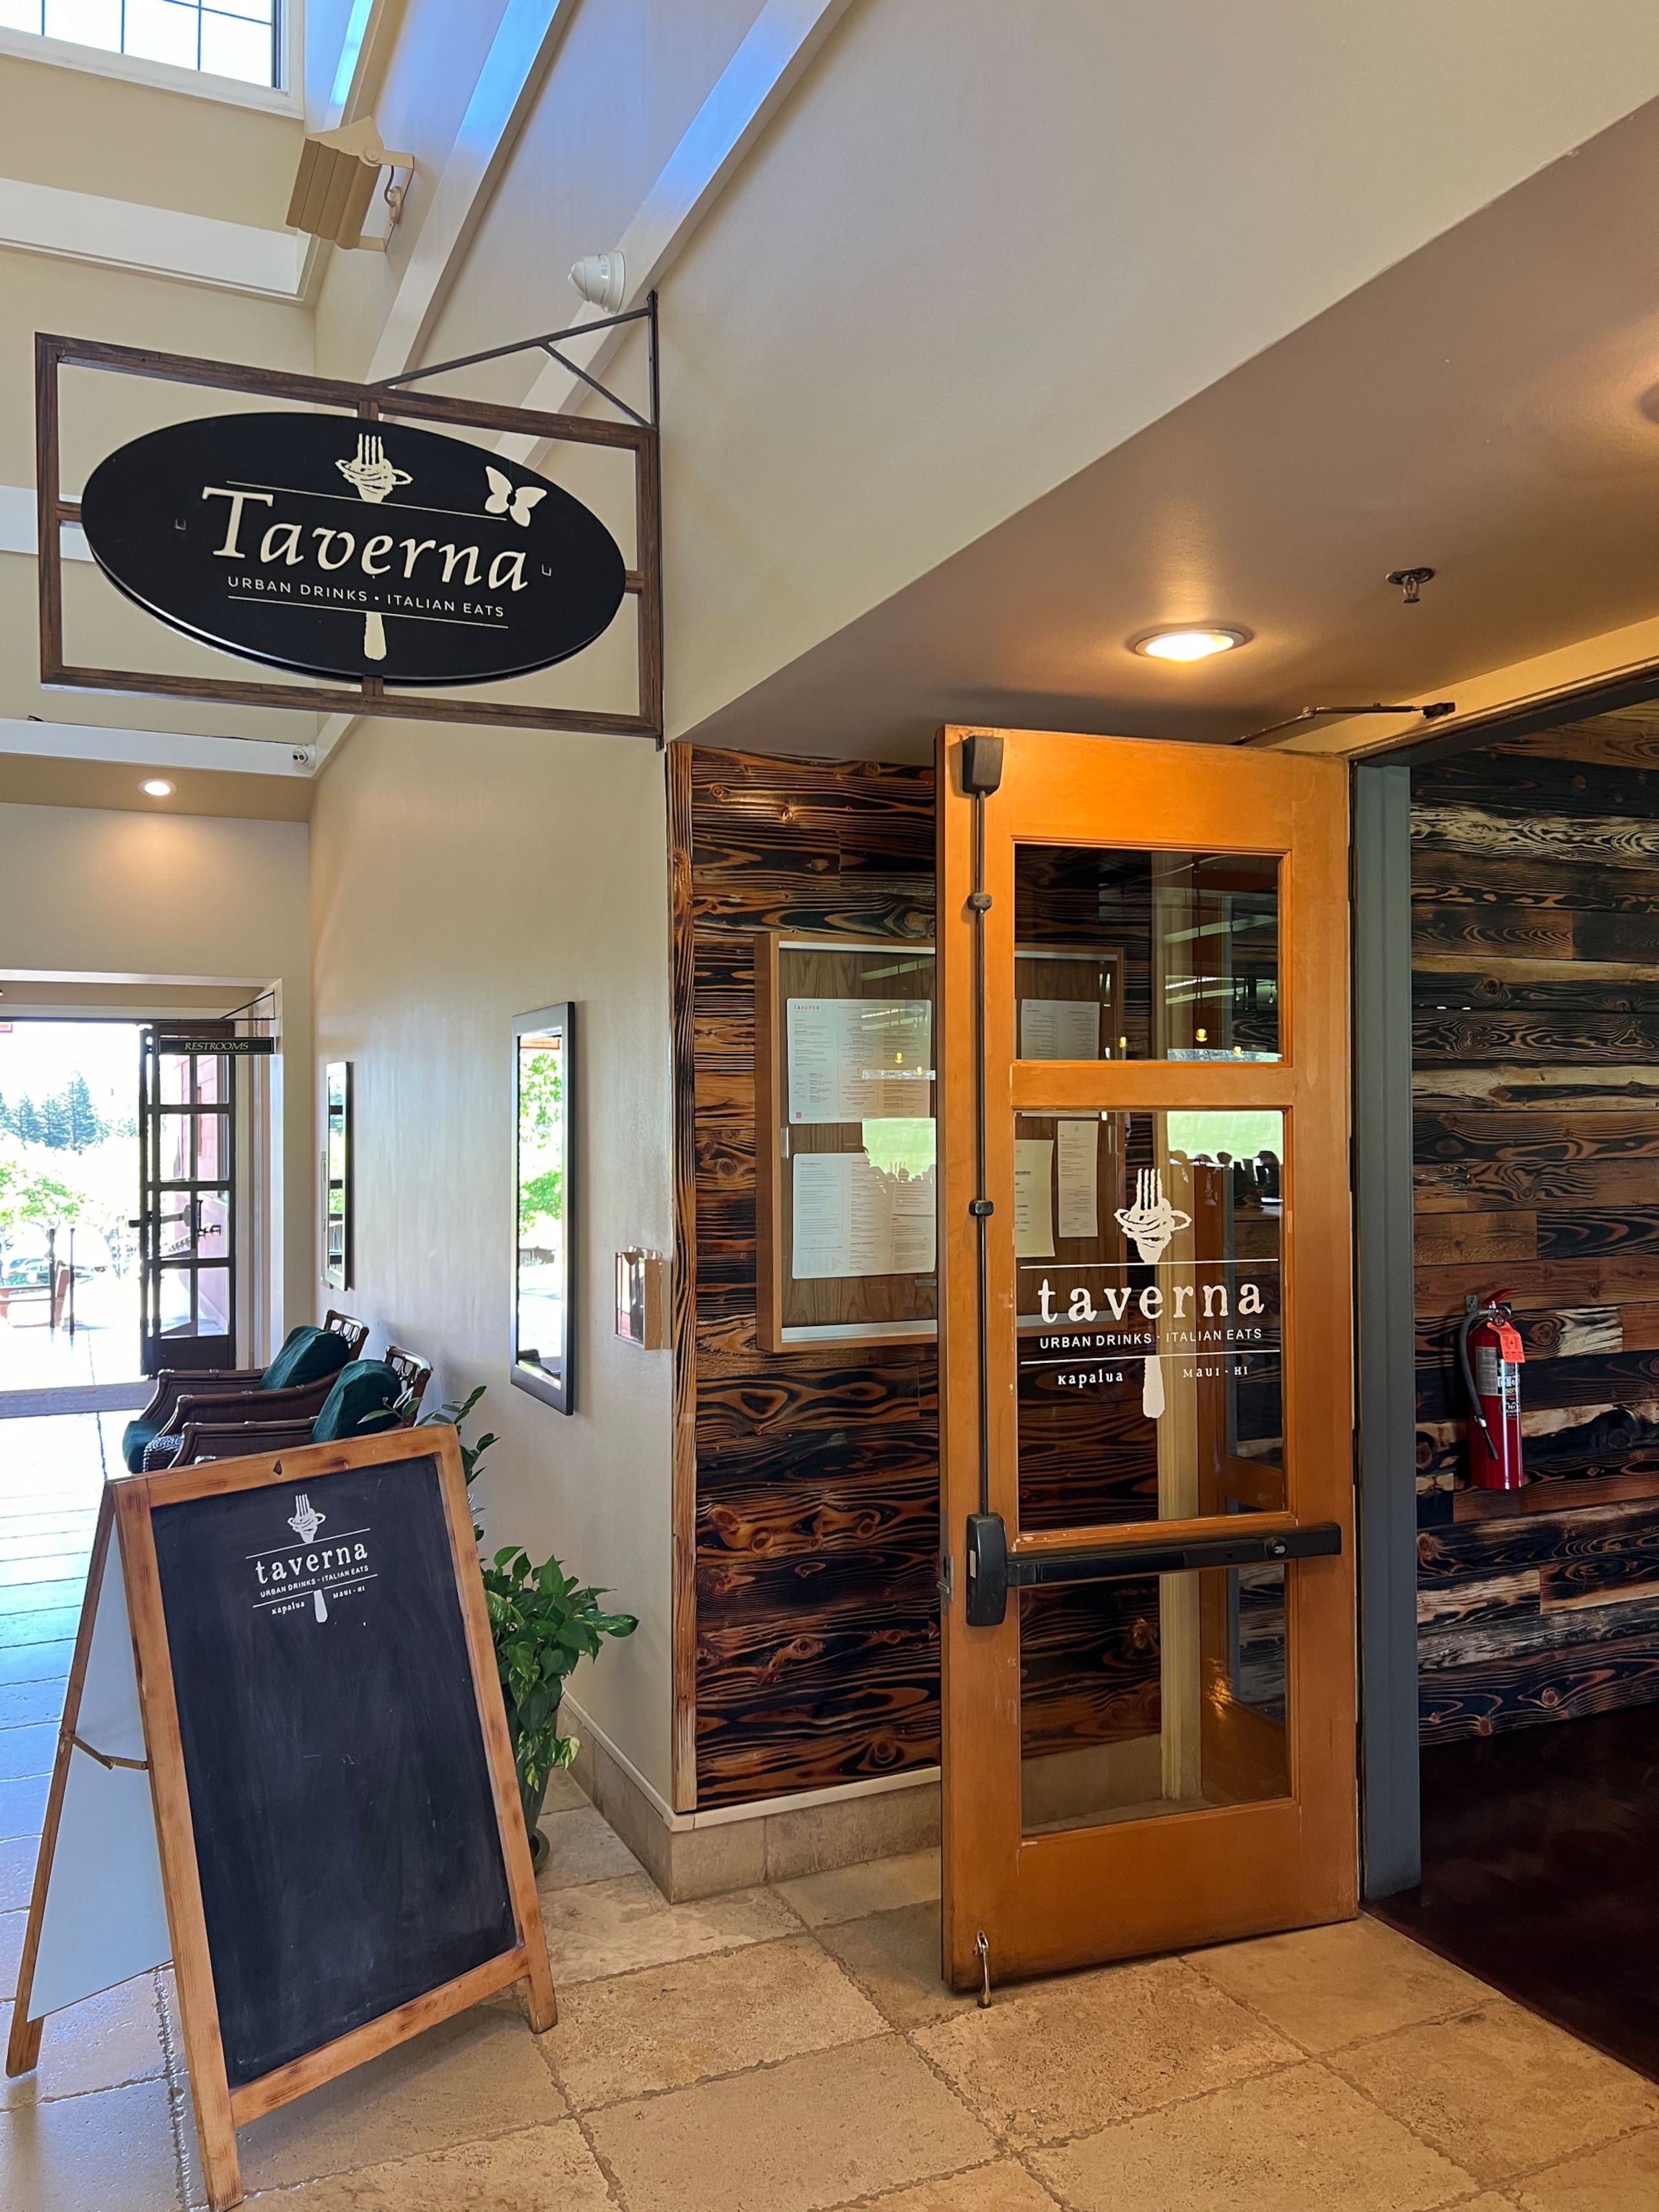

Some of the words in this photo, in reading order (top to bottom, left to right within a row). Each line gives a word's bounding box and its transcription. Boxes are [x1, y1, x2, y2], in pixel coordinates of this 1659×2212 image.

[202, 485, 529, 592] Taverna
[227, 576, 292, 593] URBAN
[300, 585, 368, 602] DRINKS
[387, 594, 456, 612] ITALIAN
[463, 603, 505, 618] EATS
[185, 1042, 249, 1051] RESTROOMS
[1038, 1278, 1265, 1323] taverna
[1039, 1336, 1091, 1349] URBAN
[1096, 1333, 1152, 1346] DRINKS
[1166, 1330, 1222, 1343] ITALIAN
[1227, 1328, 1262, 1340] EATS
[1234, 1366, 1248, 1376] HI
[255, 1543, 368, 1584] taverna
[260, 1586, 286, 1598] URBAN
[288, 1578, 316, 1591] DRINKS
[321, 1570, 350, 1583] ITALIAN
[351, 1565, 369, 1575] EATS
